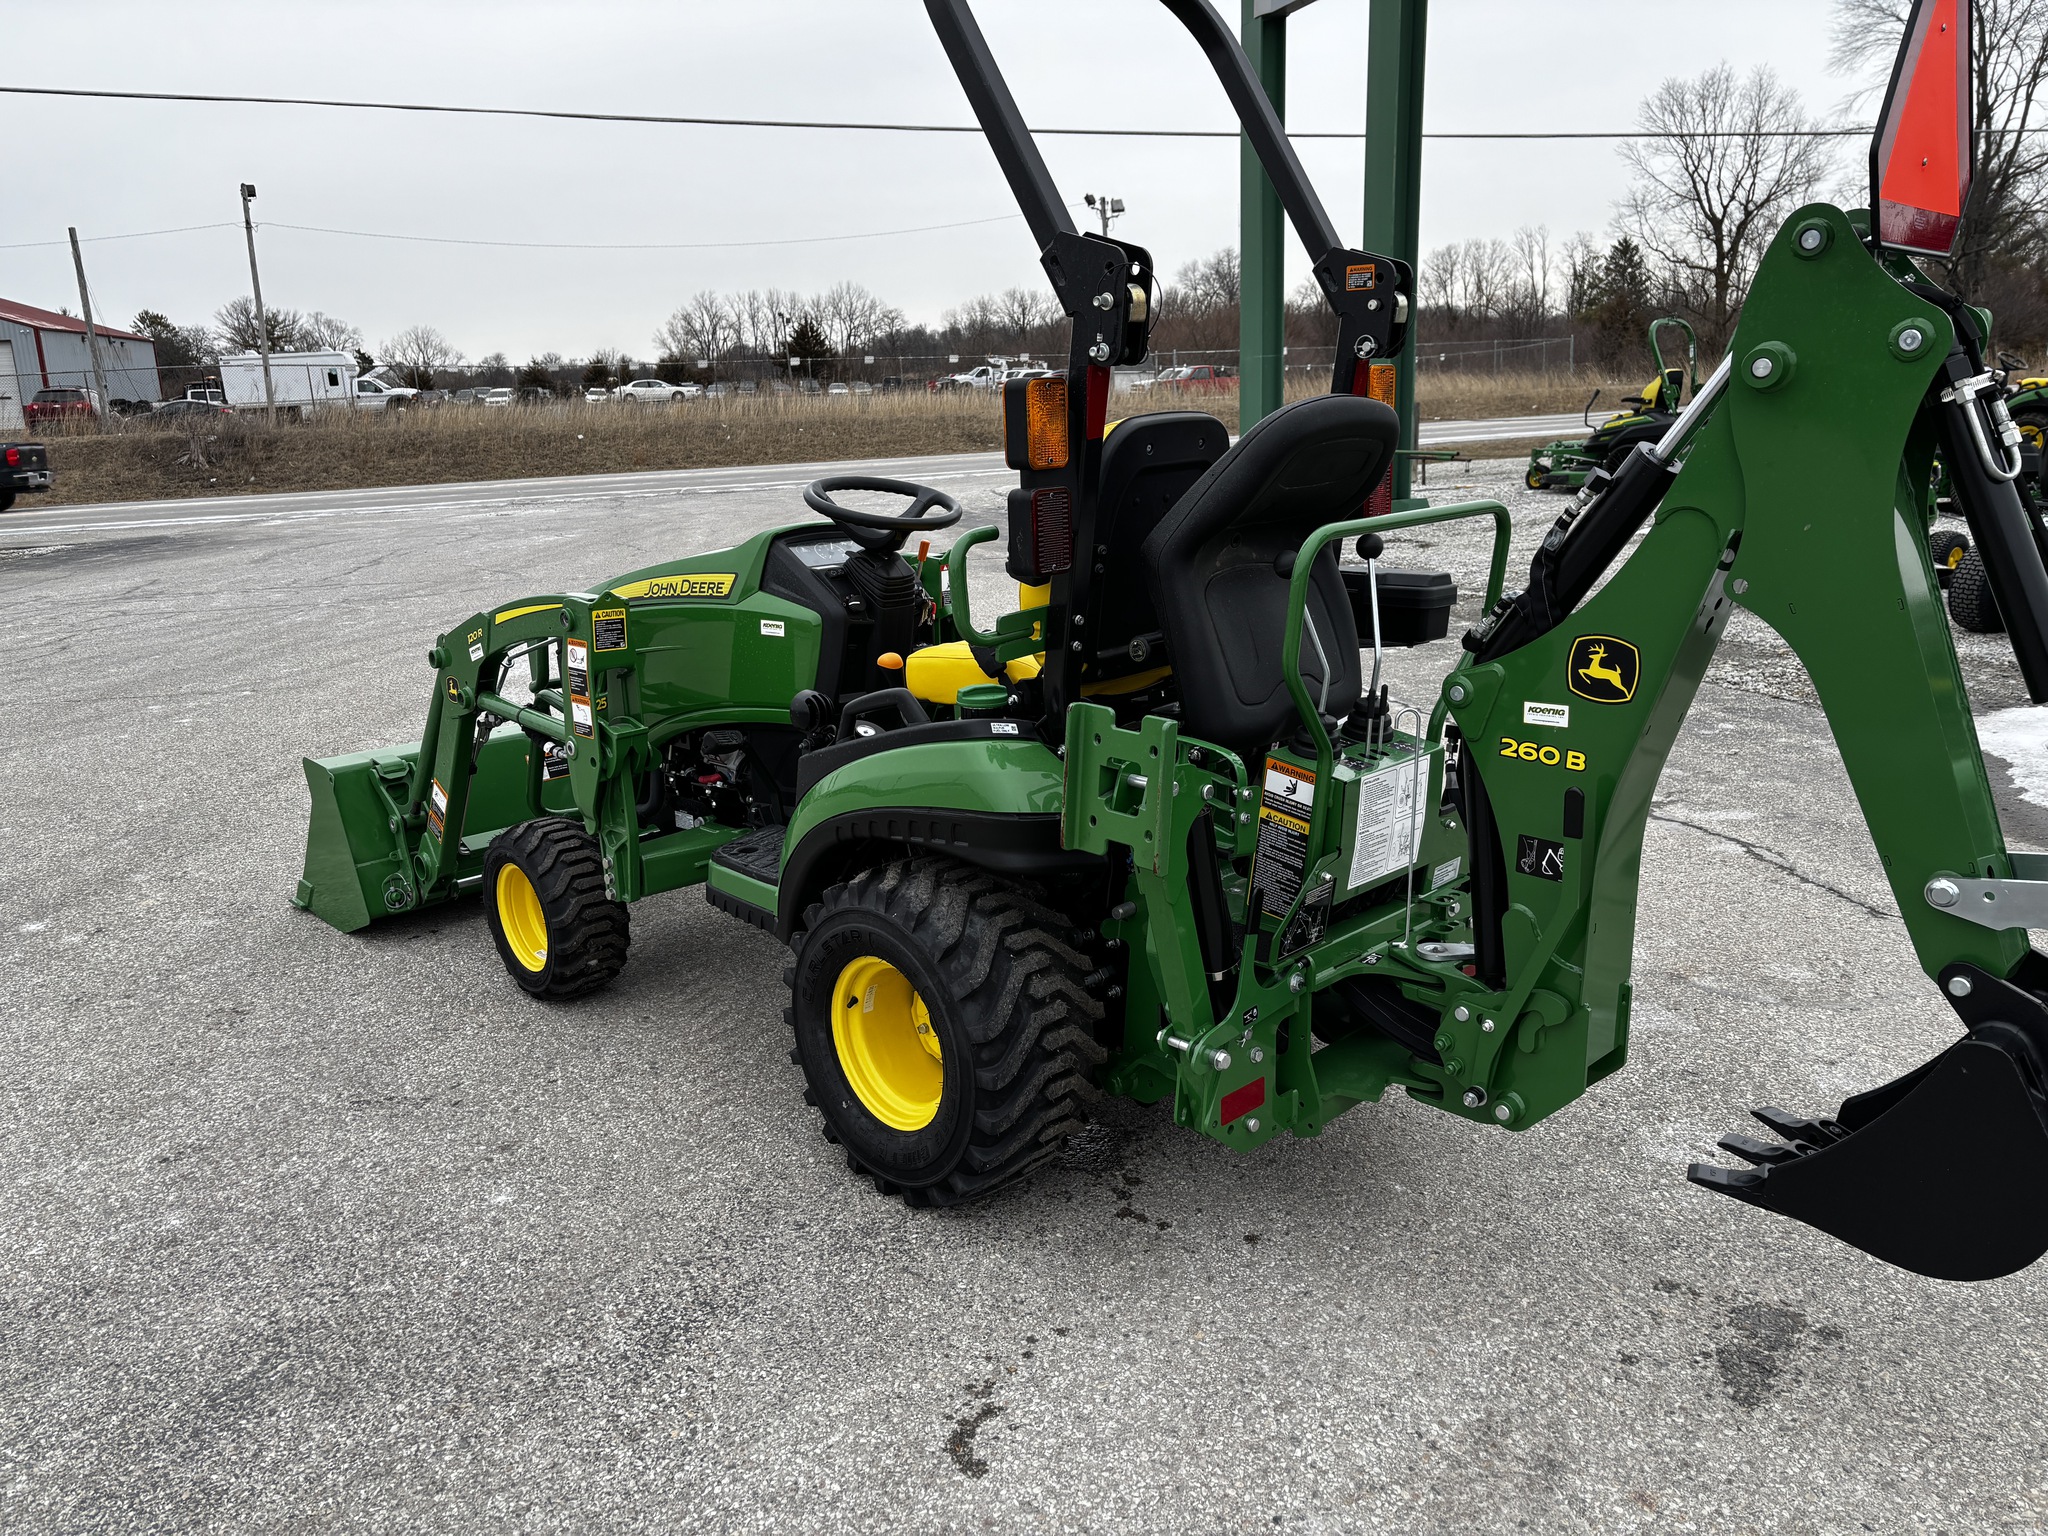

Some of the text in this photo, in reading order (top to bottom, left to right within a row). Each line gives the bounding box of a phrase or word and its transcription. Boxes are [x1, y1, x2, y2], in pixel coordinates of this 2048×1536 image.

[644, 579, 725, 597] JOHN DEERE
[602, 610, 625, 618] CAUTION
[467, 627, 484, 645] 120 R
[1499, 737, 1587, 772] 260 B
[1279, 764, 1315, 783] WARNING
[1272, 815, 1307, 833] CAUTION
[801, 929, 863, 1004] CARLSTAR
